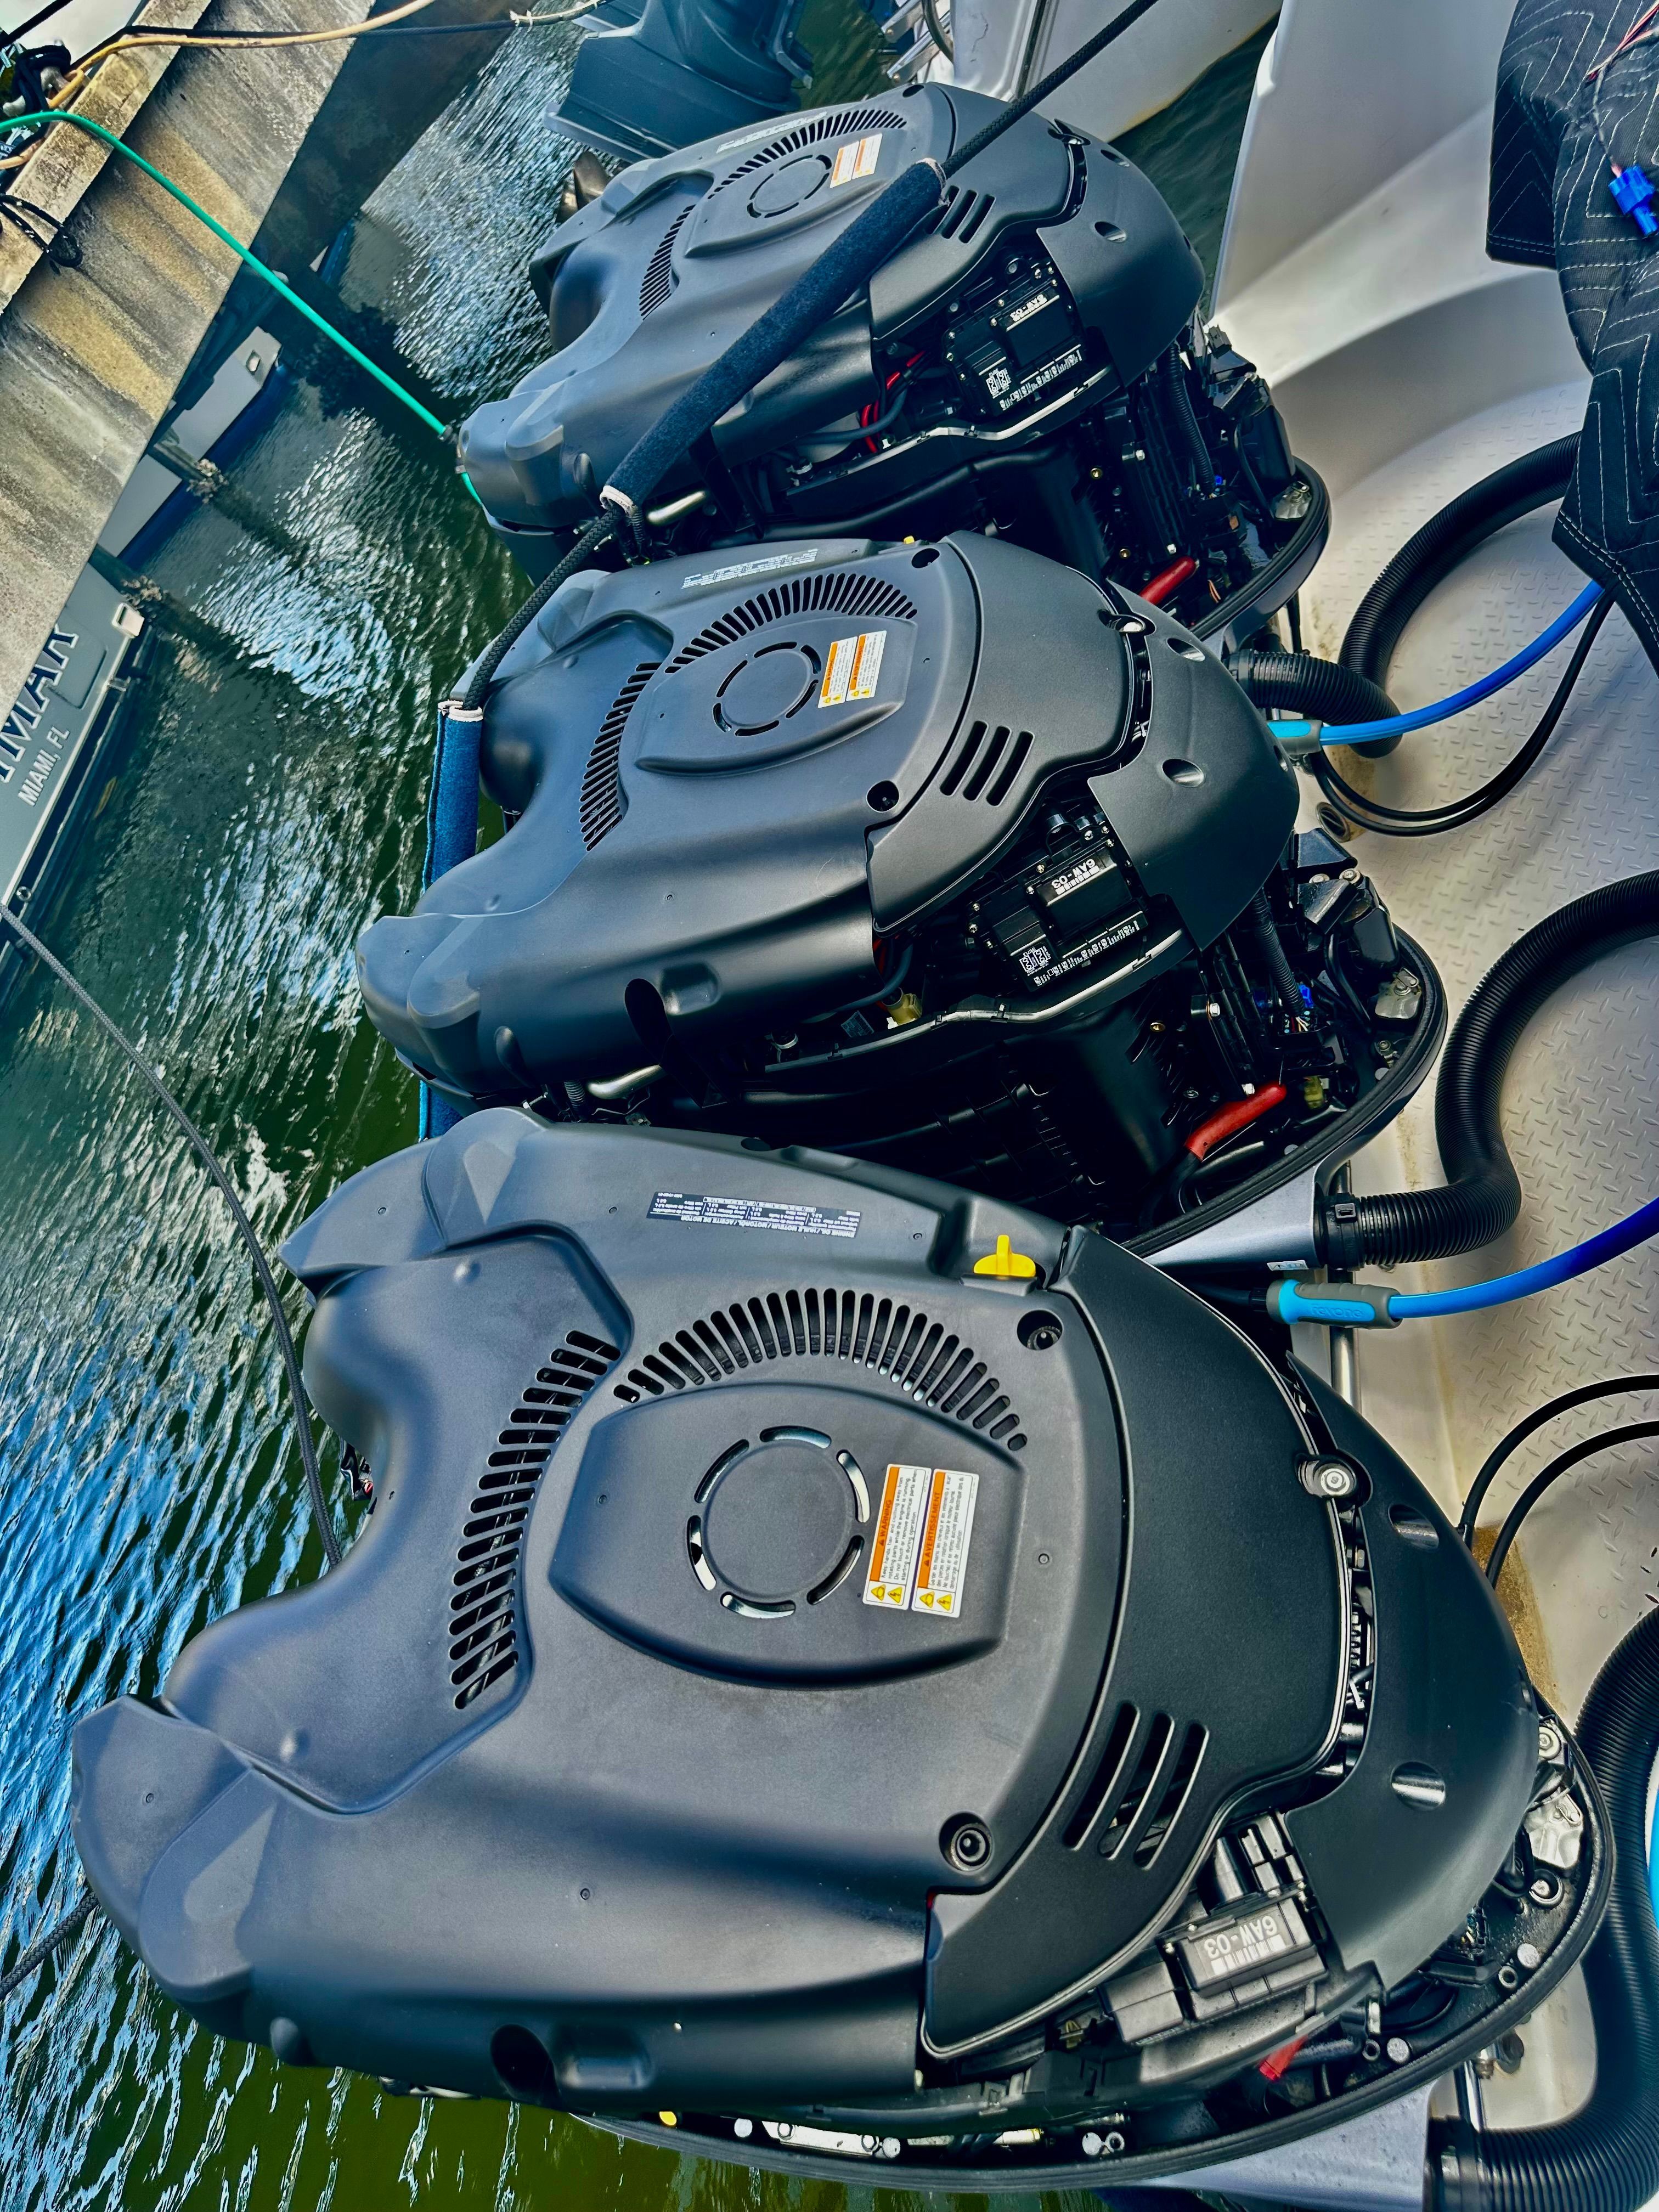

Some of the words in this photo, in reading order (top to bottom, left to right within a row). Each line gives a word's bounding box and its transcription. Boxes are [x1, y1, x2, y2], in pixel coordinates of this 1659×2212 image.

[18, 749, 61, 806] MIAMI,
[46, 725, 70, 749] FL
[1051, 858, 1096, 888] 6AW-03
[879, 1499, 891, 1536] WARNING
[924, 1492, 940, 1557] AVERTISSEMENT
[905, 1537, 913, 1553] during
[1204, 1915, 1278, 1959] 6AW-03
